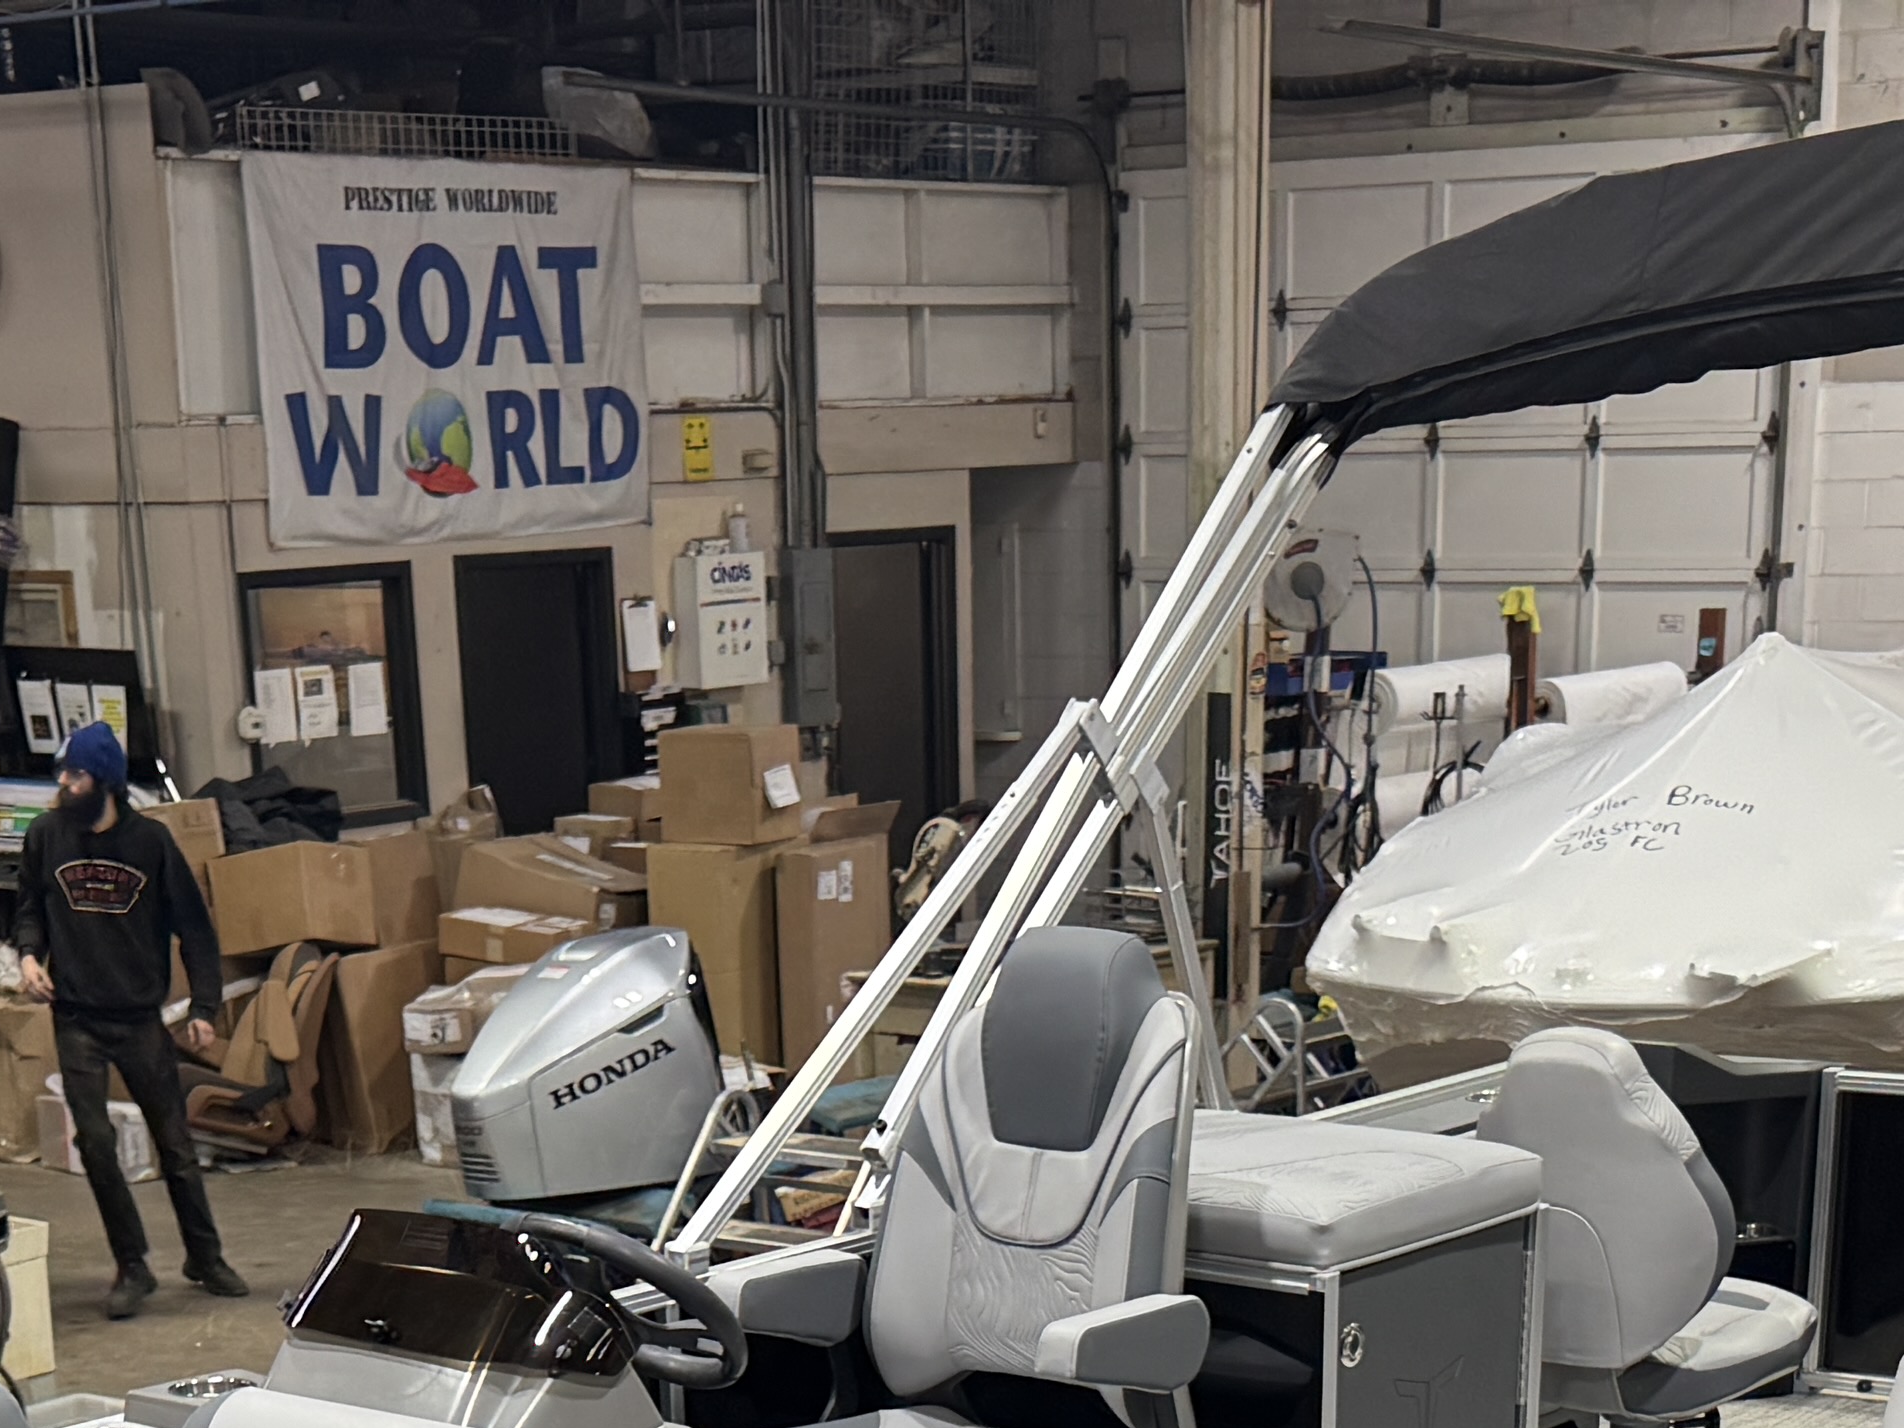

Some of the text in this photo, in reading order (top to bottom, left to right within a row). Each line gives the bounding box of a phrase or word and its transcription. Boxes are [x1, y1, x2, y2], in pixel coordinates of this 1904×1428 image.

[343, 186, 559, 216] PRESTIGE WORLDWIDE
[315, 242, 598, 370] BOAT
[1666, 784, 1755, 815] Brown
[548, 1037, 677, 1111] HONDA
